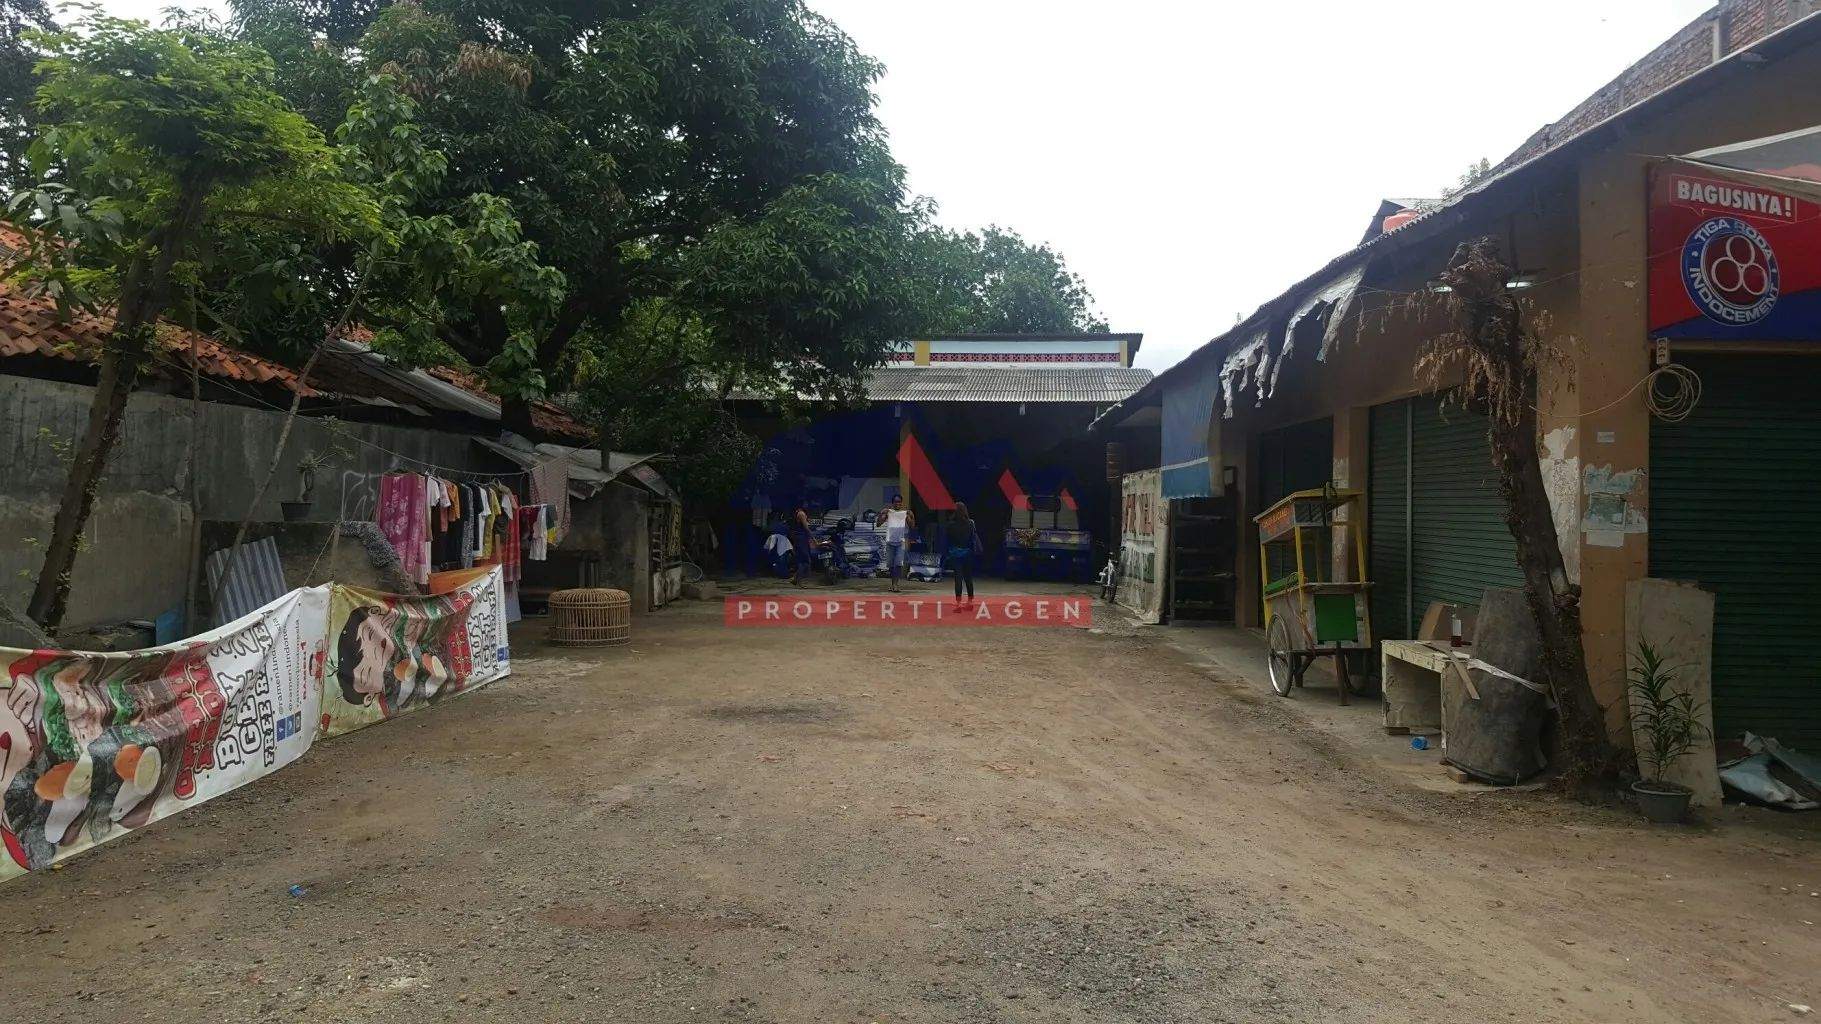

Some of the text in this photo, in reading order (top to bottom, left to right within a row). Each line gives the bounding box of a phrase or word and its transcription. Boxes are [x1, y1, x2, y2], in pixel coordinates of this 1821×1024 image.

[1694, 219, 1774, 261] TIGA RODA
[1689, 267, 1779, 322] INDOCEMENT
[468, 612, 484, 677] BUY
[479, 613, 490, 669] GET
[216, 671, 245, 770] BUY
[257, 700, 275, 768] FREE
